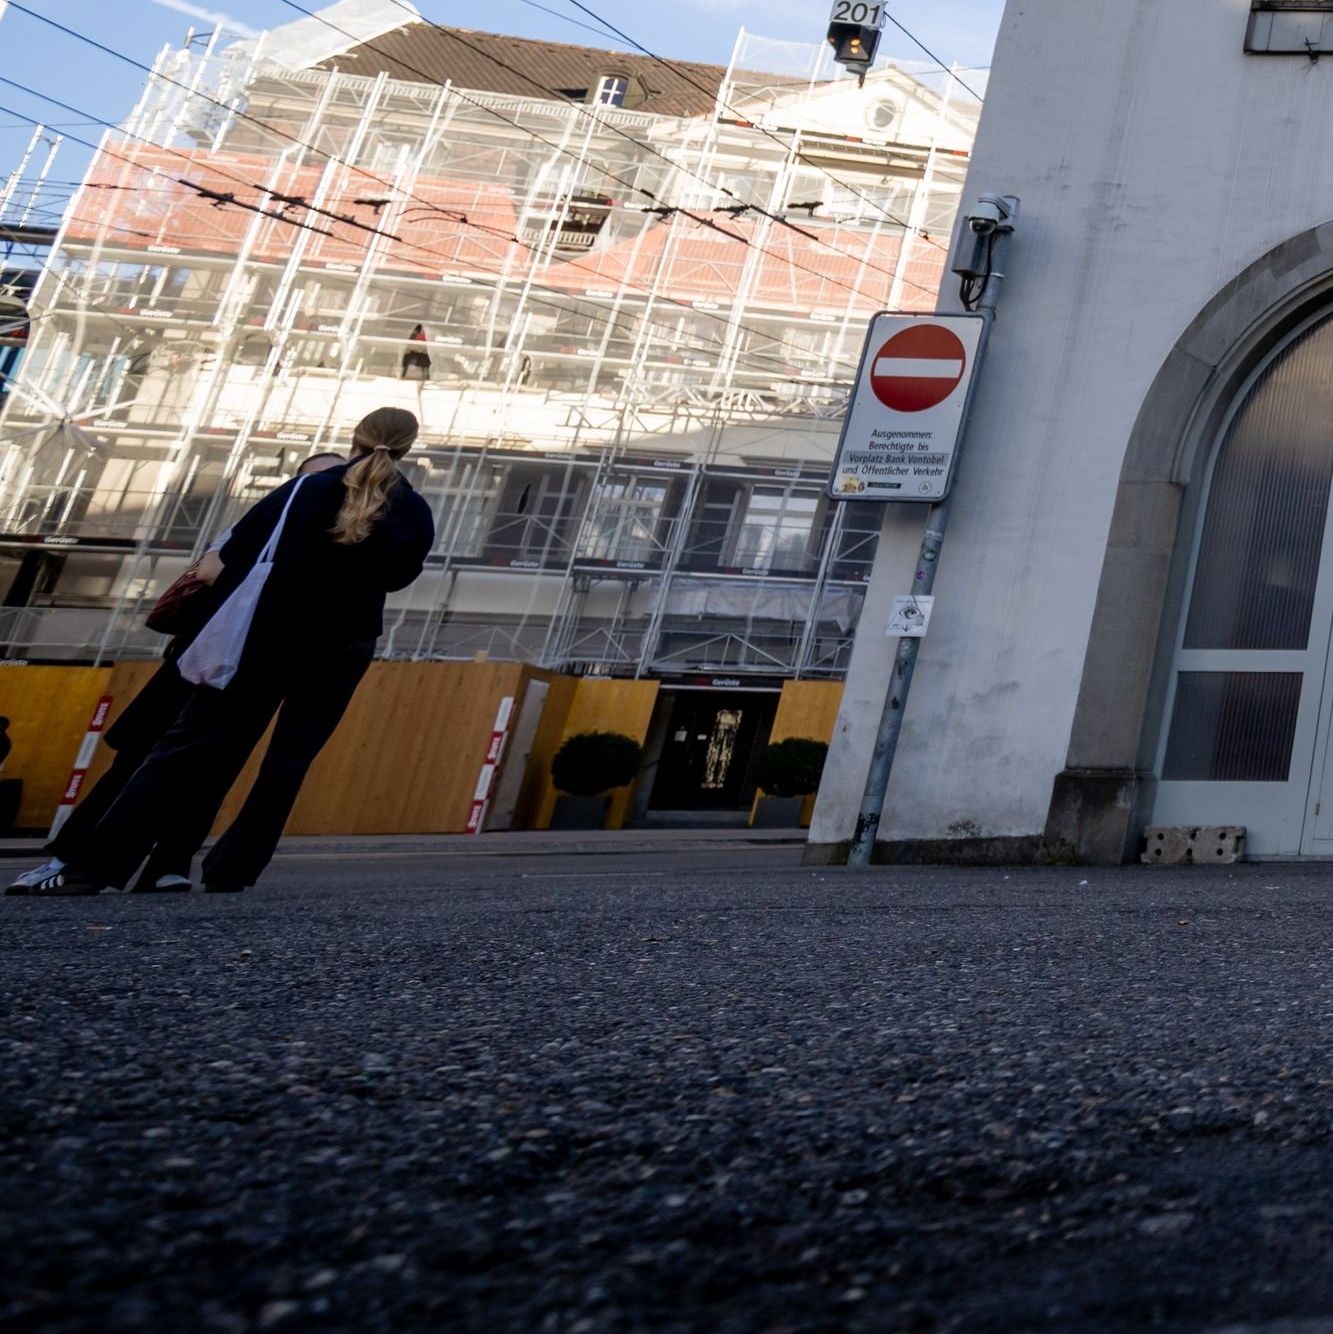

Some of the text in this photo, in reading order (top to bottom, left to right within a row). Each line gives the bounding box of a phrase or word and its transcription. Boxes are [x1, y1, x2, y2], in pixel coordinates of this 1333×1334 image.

[833, 0, 882, 24] 201
[871, 429, 933, 440] Ausgenommen:
[868, 441, 929, 453] Berechtigte bis
[849, 454, 945, 464] Vorplatz Bank Vontobel
[842, 464, 944, 476] und Öffentlicher Verkehr
